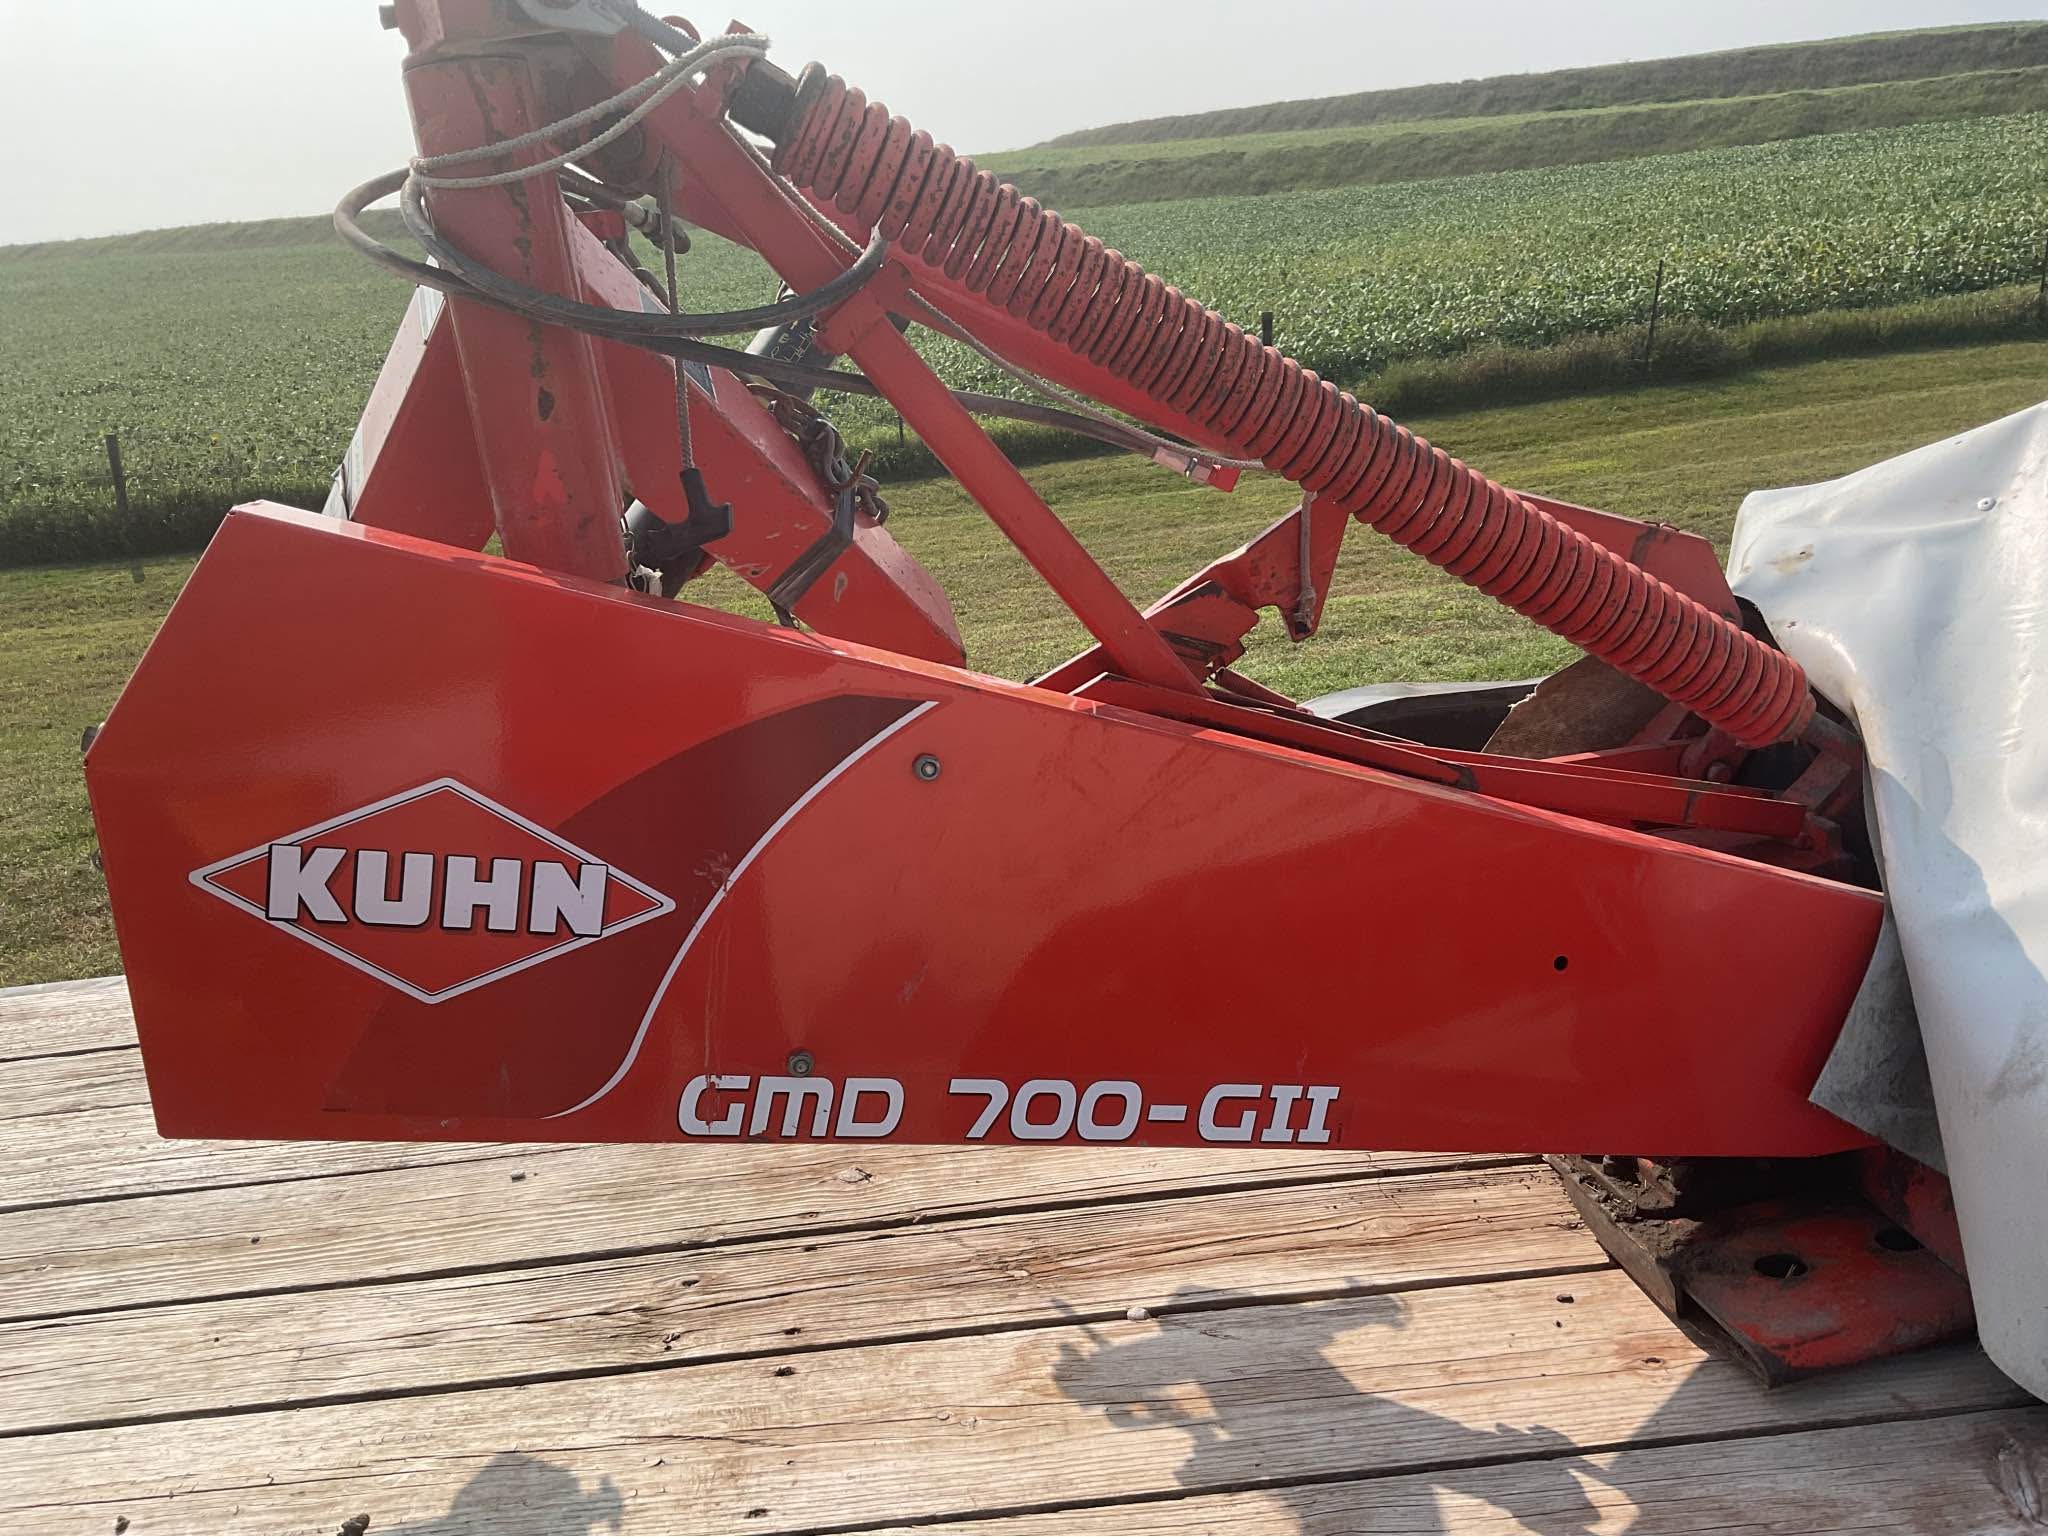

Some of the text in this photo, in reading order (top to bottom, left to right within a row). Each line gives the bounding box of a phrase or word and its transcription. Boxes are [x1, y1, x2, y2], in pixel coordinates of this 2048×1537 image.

[267, 843, 607, 937] KUHN
[678, 1074, 1341, 1143] GMD 700-GII
